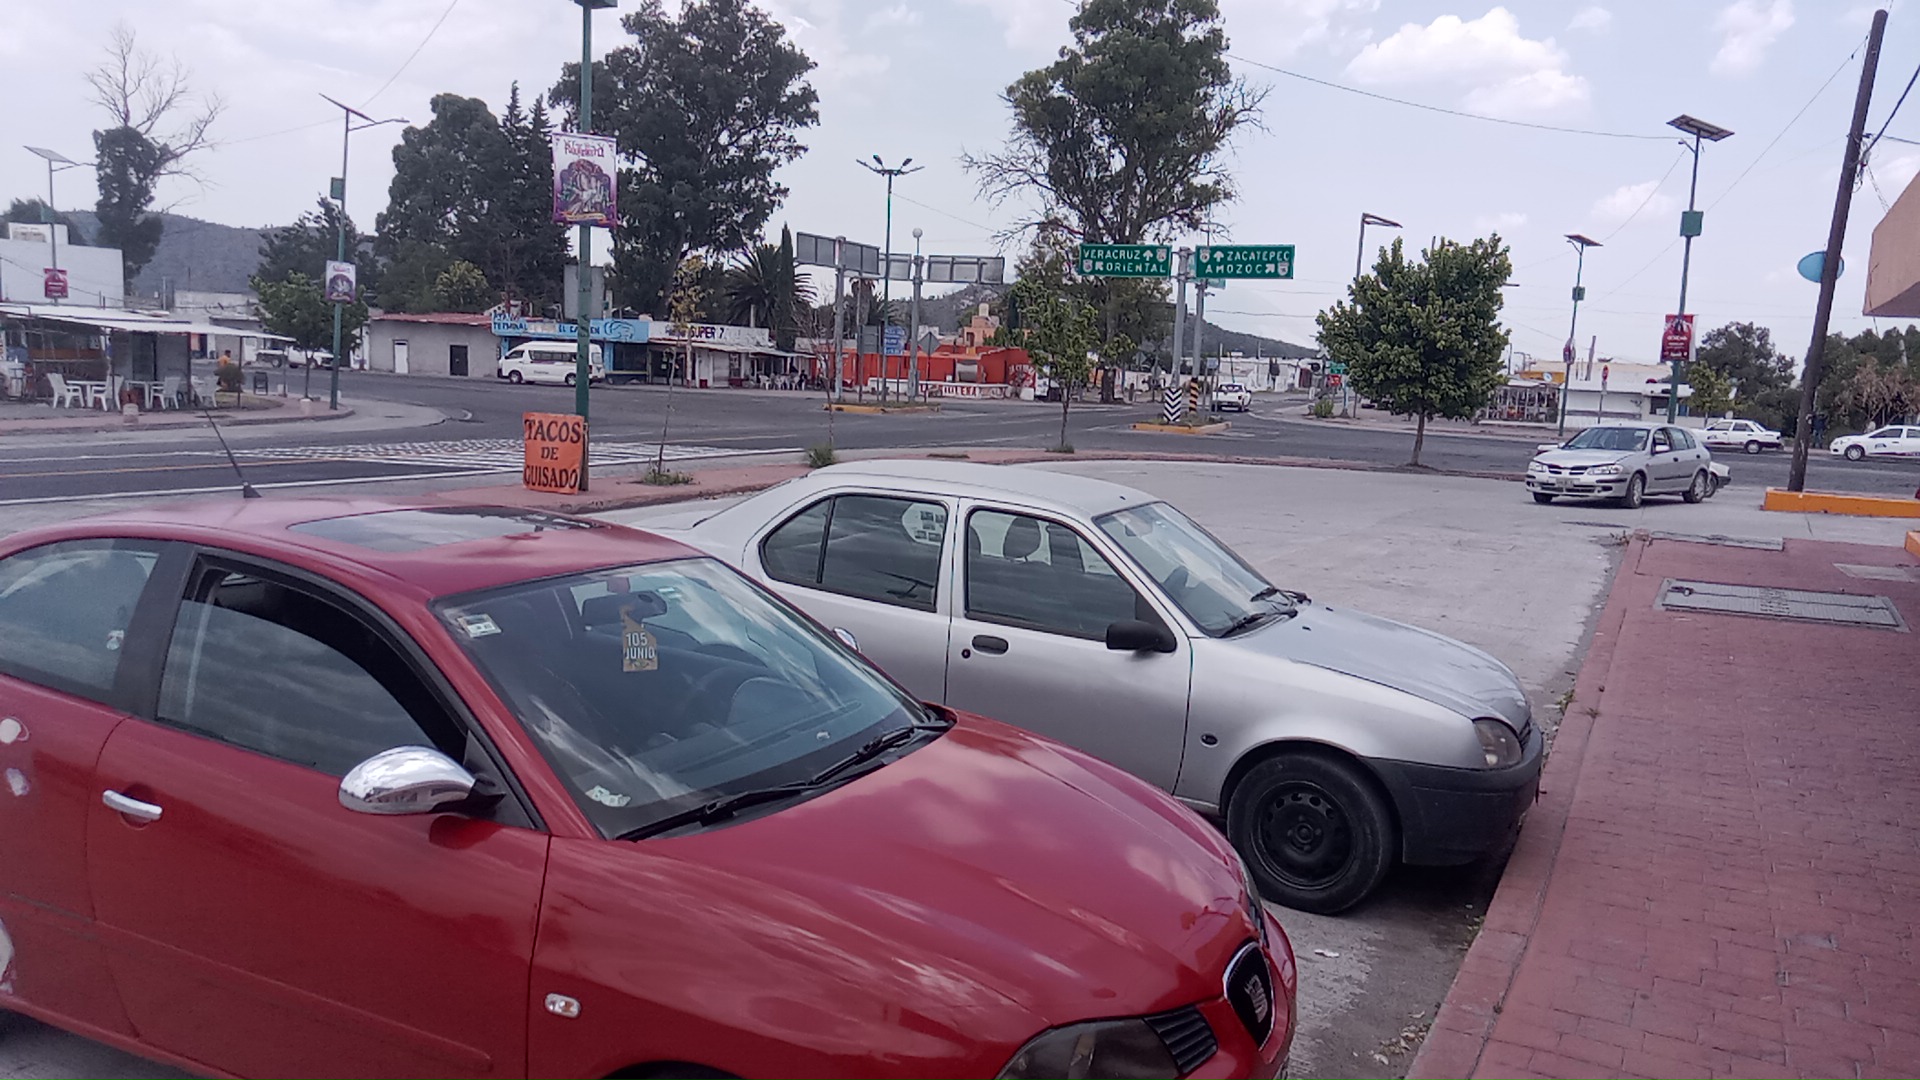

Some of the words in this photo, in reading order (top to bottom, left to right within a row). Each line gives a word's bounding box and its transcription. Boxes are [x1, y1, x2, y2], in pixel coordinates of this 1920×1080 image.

[1083, 249, 1141, 260] VERACRUZ
[1226, 250, 1291, 262] ZACATEPEC
[1106, 262, 1167, 273] ORIENTAL
[1205, 263, 1263, 274] AMOZOC
[690, 325, 717, 339] SUPER
[524, 418, 581, 444] TACOS
[541, 446, 559, 461] DE
[524, 464, 578, 489] GUISADO
[625, 632, 648, 647] 105
[625, 646, 656, 660] JUNIO
